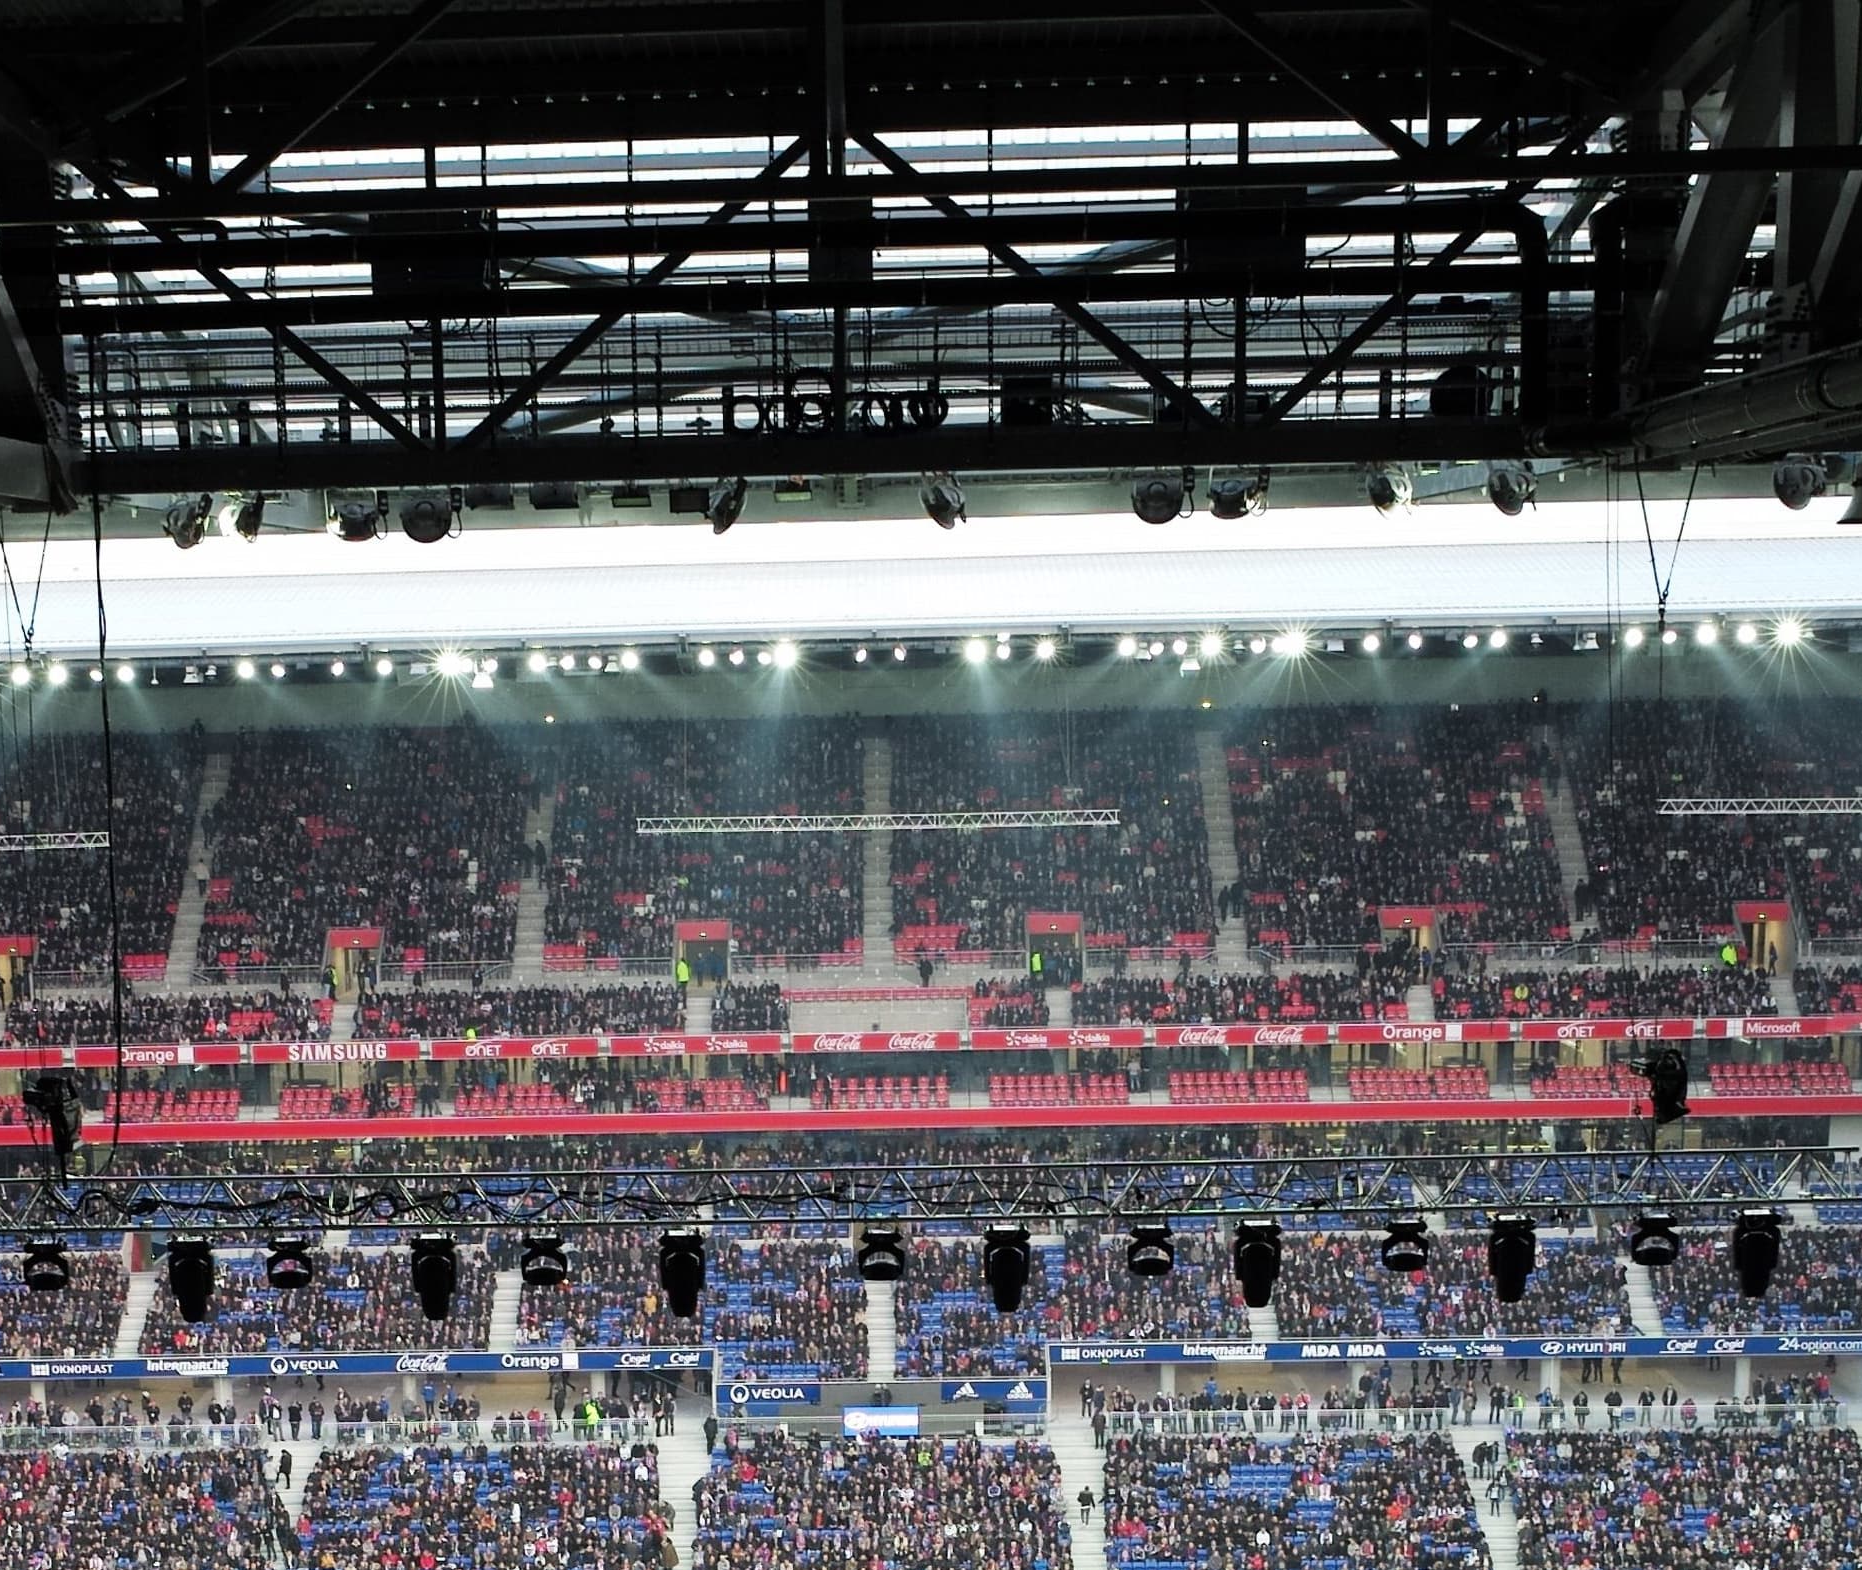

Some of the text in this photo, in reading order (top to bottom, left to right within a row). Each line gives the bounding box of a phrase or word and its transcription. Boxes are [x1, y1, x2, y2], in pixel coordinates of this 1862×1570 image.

[1383, 1025, 1442, 1042] Orange
[1746, 1020, 1801, 1034] Microsoft
[288, 1043, 387, 1061] SAMSUNG
[1082, 1348, 1146, 1359] OKNOPLAST
[1301, 1344, 1340, 1357] MDA
[1347, 1343, 1386, 1356] MDA
[290, 1360, 338, 1371] VEOLIA
[501, 1354, 560, 1370] Orange
[52, 1364, 113, 1375] OKNOPLAST
[751, 1388, 804, 1400] VEOLIA
